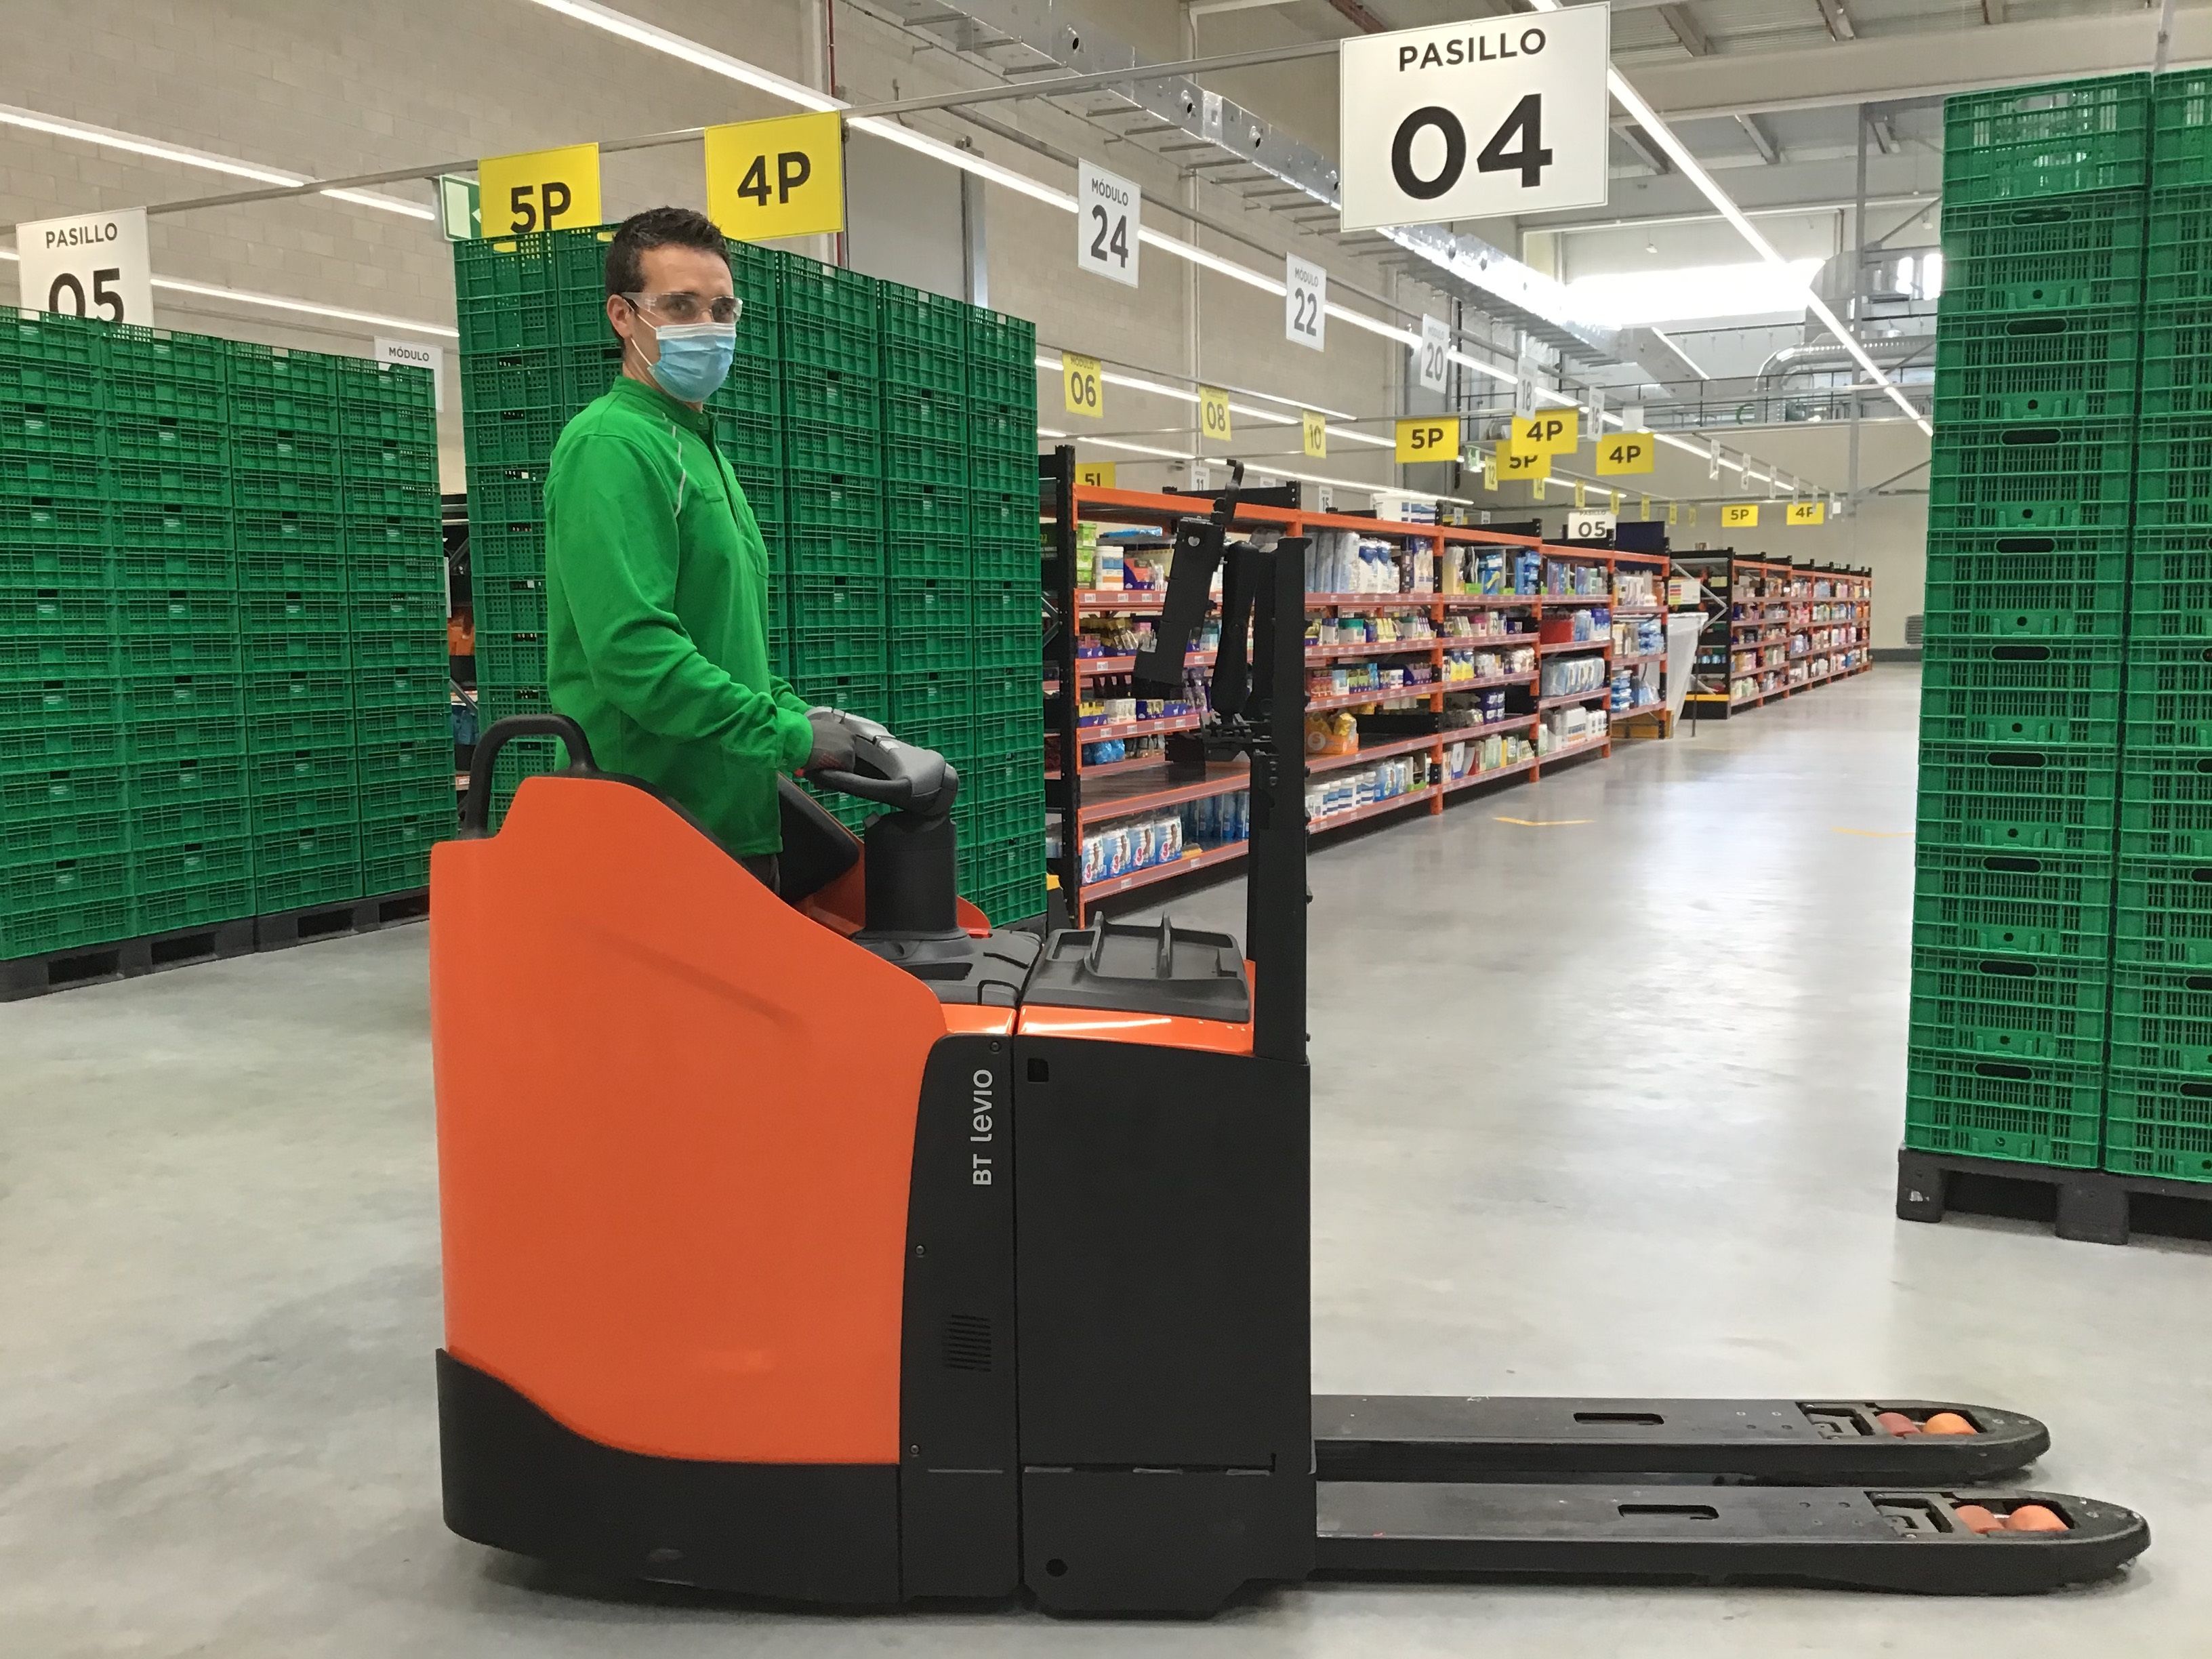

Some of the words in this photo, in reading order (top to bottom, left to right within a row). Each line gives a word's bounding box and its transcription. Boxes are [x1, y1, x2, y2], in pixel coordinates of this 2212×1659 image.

[1399, 28, 1547, 73] PASILLO
[1391, 93, 1553, 201] 04
[737, 150, 811, 206] 4P
[1091, 177, 1129, 207] MÓDULO
[510, 181, 571, 234] 5P
[45, 222, 118, 249] PASILLO
[1090, 204, 1129, 269] 24
[48, 267, 125, 323] 05
[1294, 287, 1318, 337] 22
[388, 346, 430, 362] MÓDULO
[1425, 342, 1443, 382] 20
[1071, 371, 1097, 407] 06
[1521, 379, 1532, 412] 18
[1206, 401, 1226, 432] 08
[1526, 420, 1563, 443] 4P
[1309, 424, 1322, 450] 10
[1411, 428, 1444, 449] 5P
[1509, 455, 1538, 470] 5P
[1609, 445, 1641, 464] 4P
[1578, 521, 1606, 537] 05
[1731, 509, 1750, 520] 5P
[972, 1153, 992, 1186] BT
